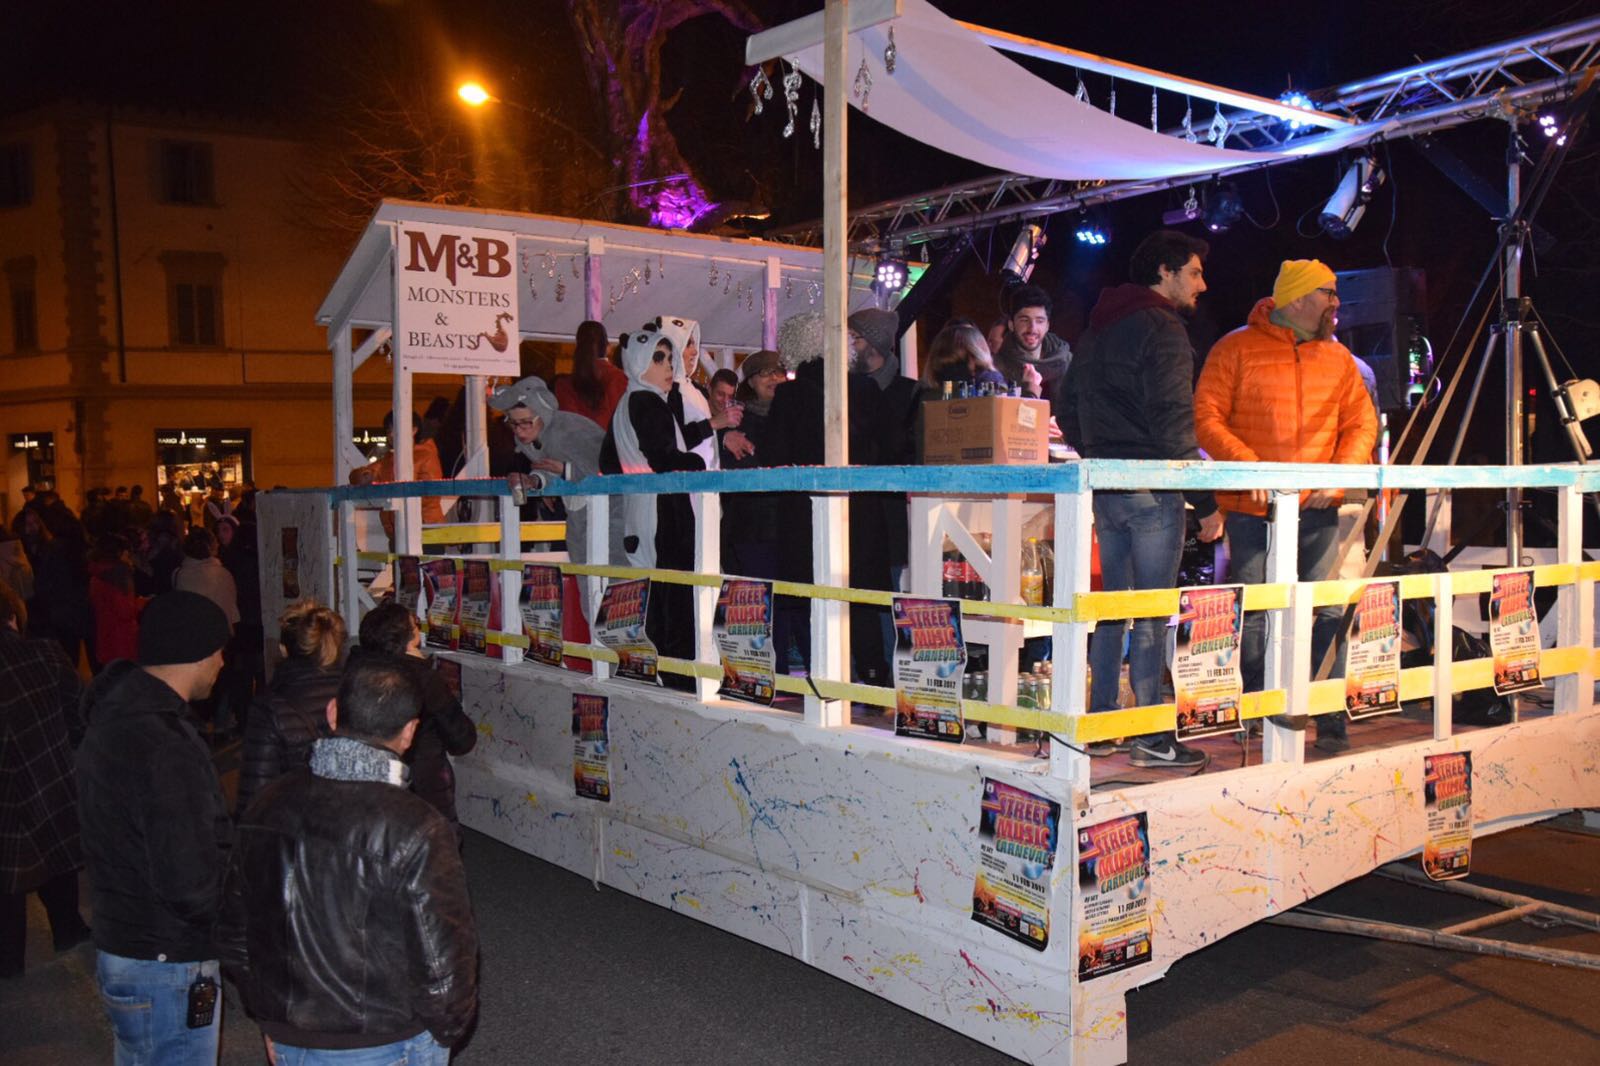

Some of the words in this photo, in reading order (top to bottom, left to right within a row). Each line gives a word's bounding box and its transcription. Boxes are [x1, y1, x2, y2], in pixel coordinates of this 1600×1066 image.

[404, 230, 512, 286] M&B
[407, 286, 511, 308] MONSTERS
[434, 311, 449, 326] &
[408, 331, 478, 349] BEASTS
[727, 604, 766, 625] MUSIC
[908, 605, 952, 628] STREET
[1193, 591, 1236, 621] STREET
[913, 627, 957, 649] MUSIC
[1192, 614, 1235, 644] MUSIC
[913, 649, 961, 662] CARNEVAL
[1191, 638, 1234, 656] CARNEVAL
[1000, 792, 1051, 825] STREET
[996, 816, 1051, 849] MUSIC
[1095, 819, 1139, 856] STREET
[996, 839, 1049, 864] CARNEVAL
[1098, 840, 1144, 880] MUSIC
[1101, 864, 1146, 894] CARNEVAL
